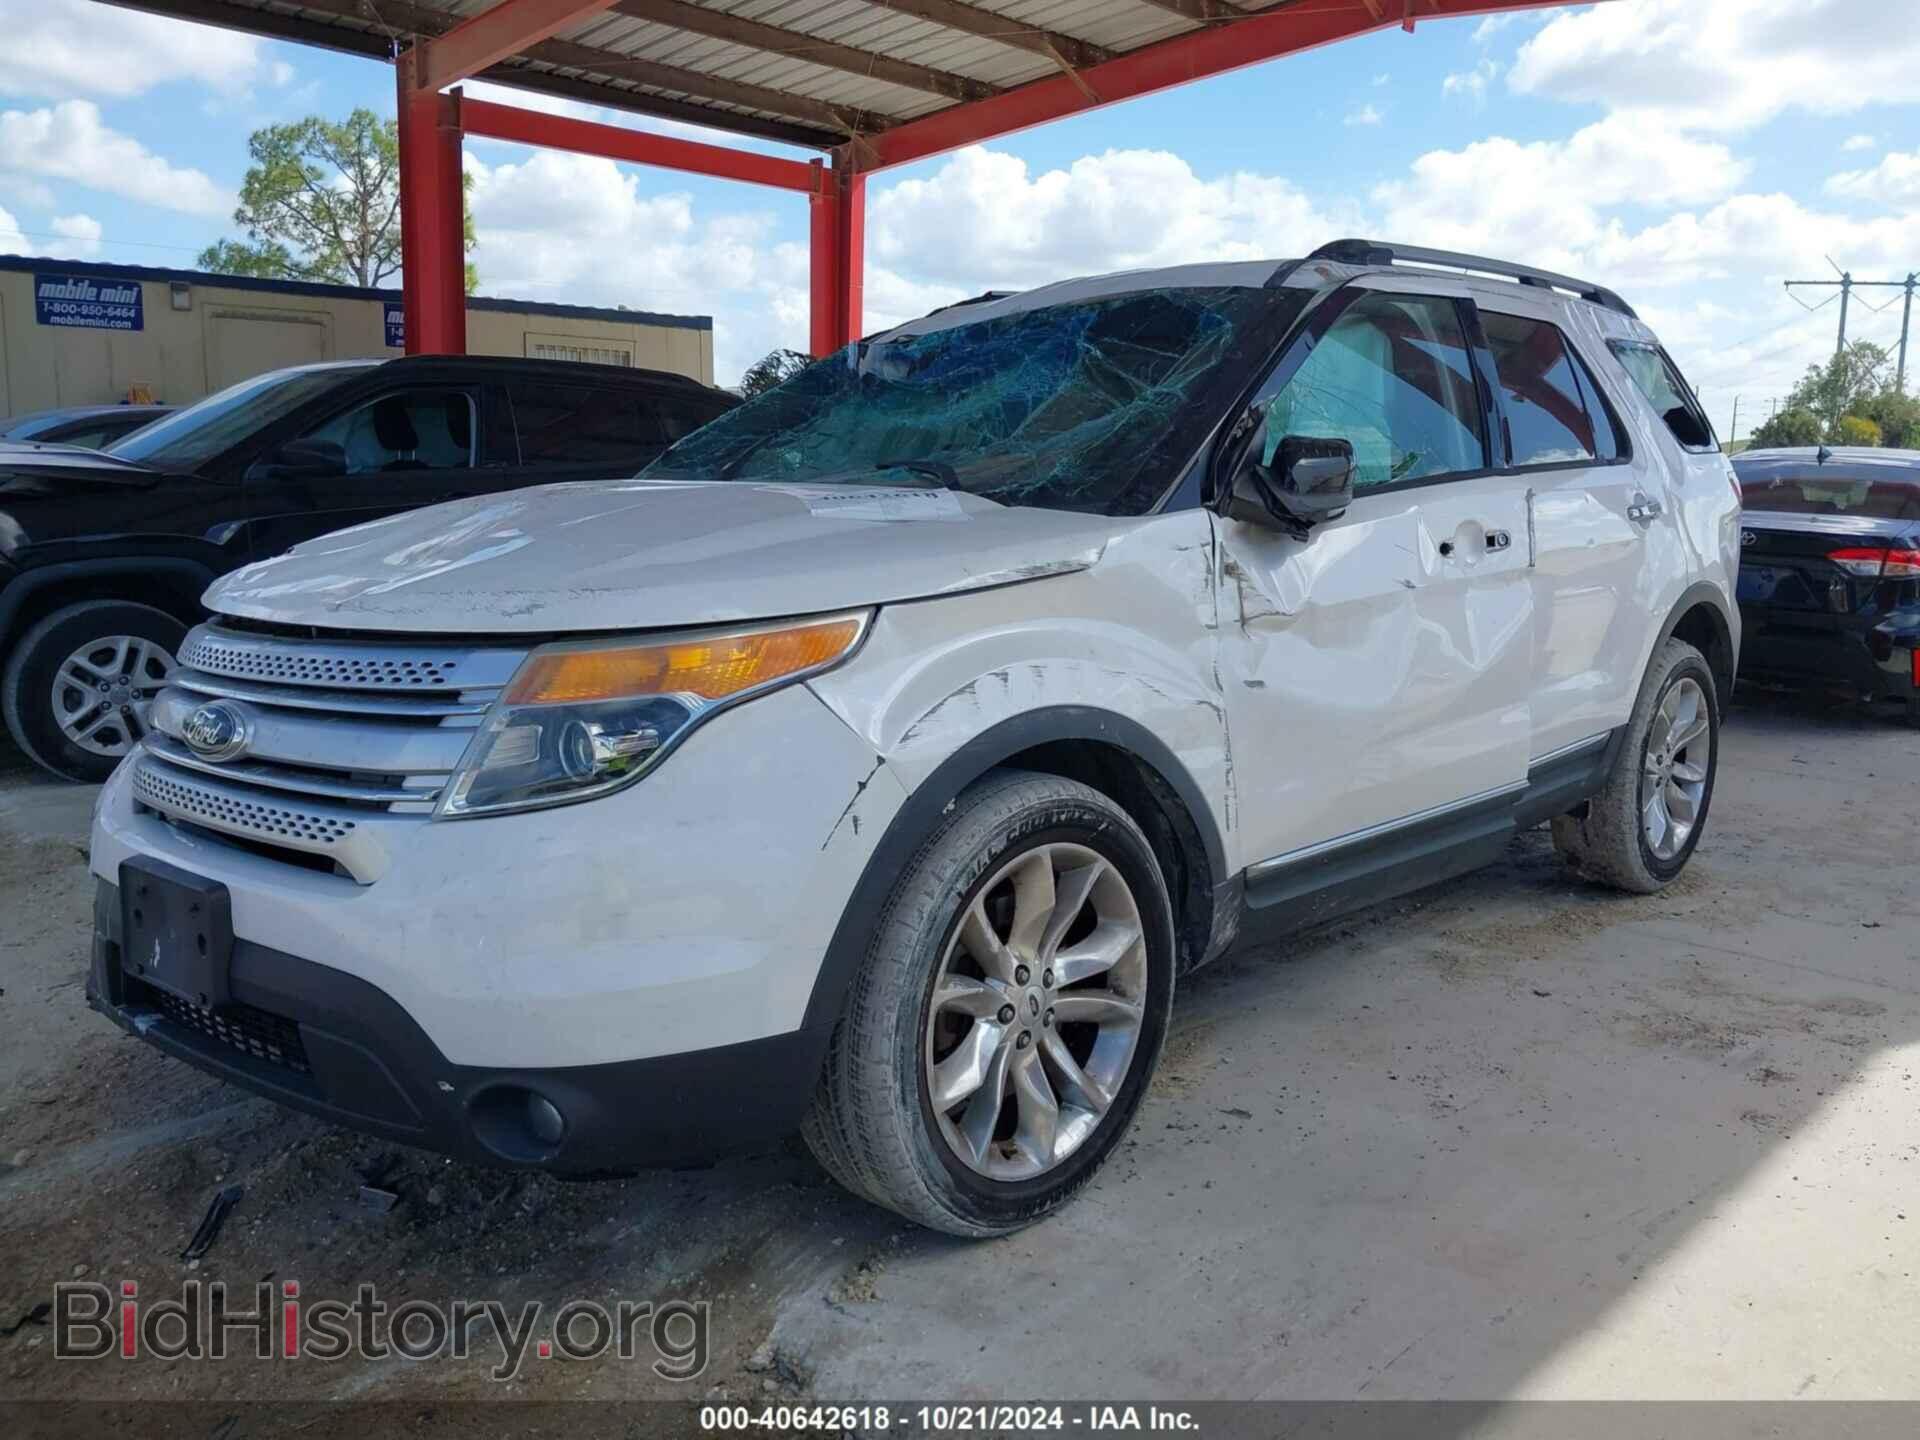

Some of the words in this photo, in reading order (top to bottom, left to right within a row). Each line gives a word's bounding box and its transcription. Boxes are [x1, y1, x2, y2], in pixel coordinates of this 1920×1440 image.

[38, 278, 97, 301] mobile
[99, 286, 139, 304] mini
[43, 302, 136, 318] 1-800-950-6464
[49, 315, 132, 329] mobilemini.com
[182, 710, 222, 744] Ford
